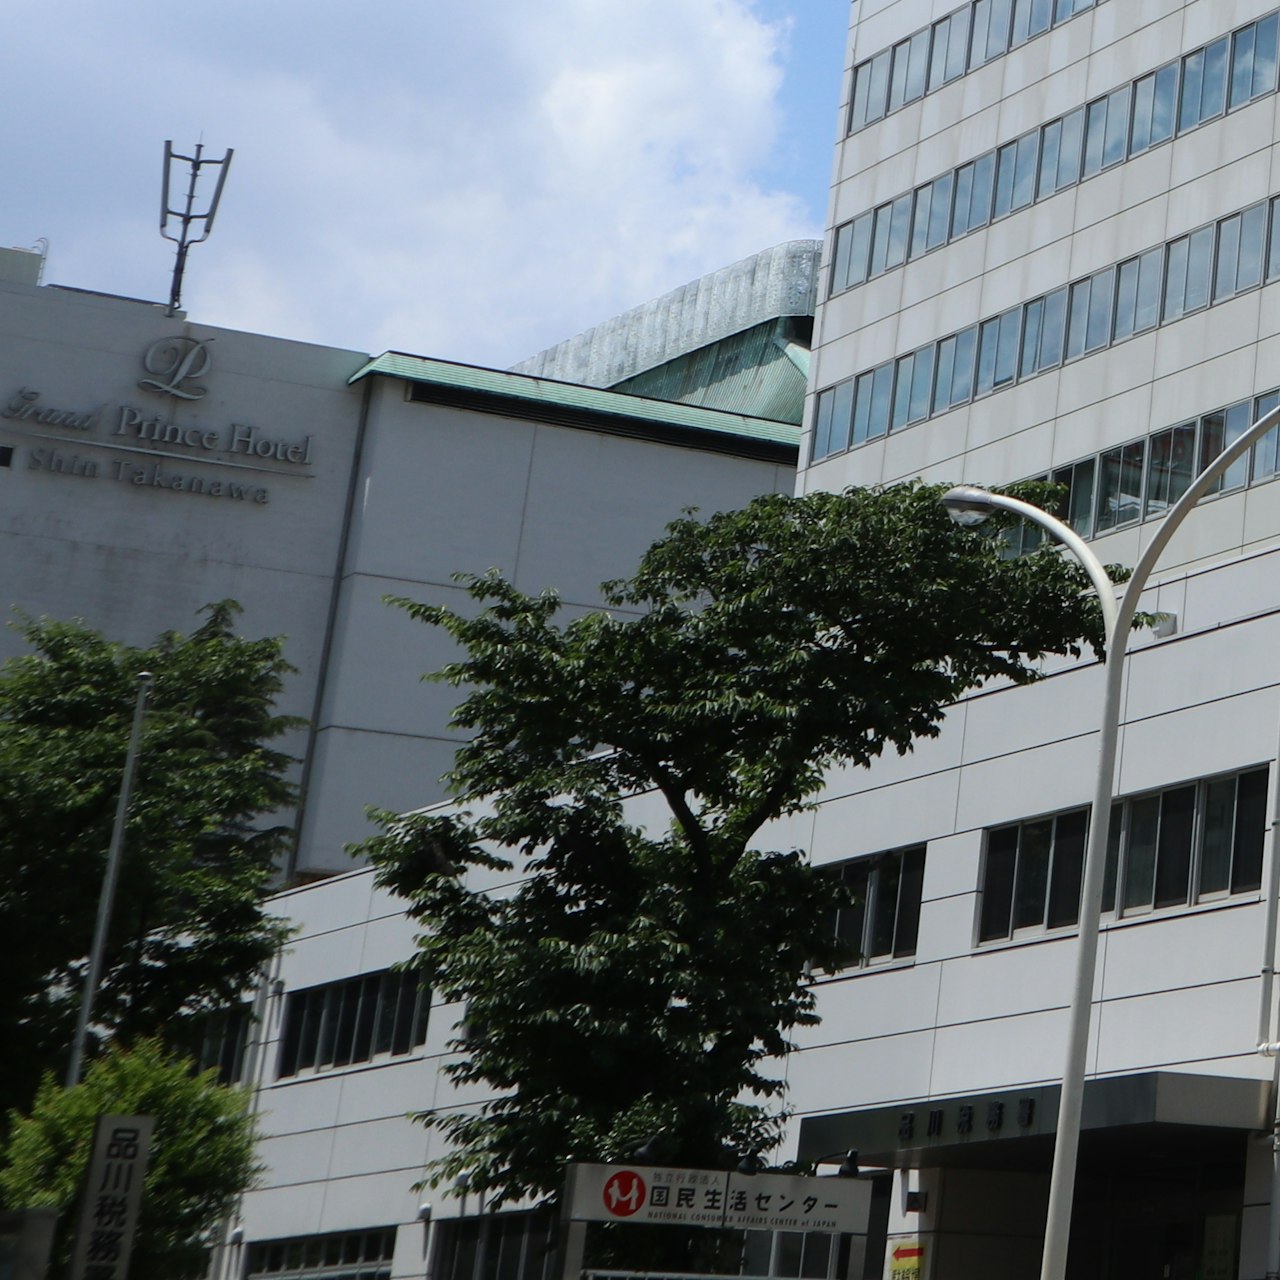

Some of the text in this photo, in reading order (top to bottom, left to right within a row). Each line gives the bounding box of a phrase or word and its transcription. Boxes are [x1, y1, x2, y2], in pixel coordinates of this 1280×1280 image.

[1, 386, 315, 465] Grand Prince Hotel
[28, 447, 270, 505] Shin Takanawa
[648, 1211, 687, 1221] NATIONAL
[690, 1213, 734, 1224] CONSUMER
[737, 1215, 768, 1225] AFFAIRS
[770, 1217, 798, 1227] CENTER
[813, 1219, 837, 1228] JAPAN
[650, 1186, 839, 1215] 国民生活センター
